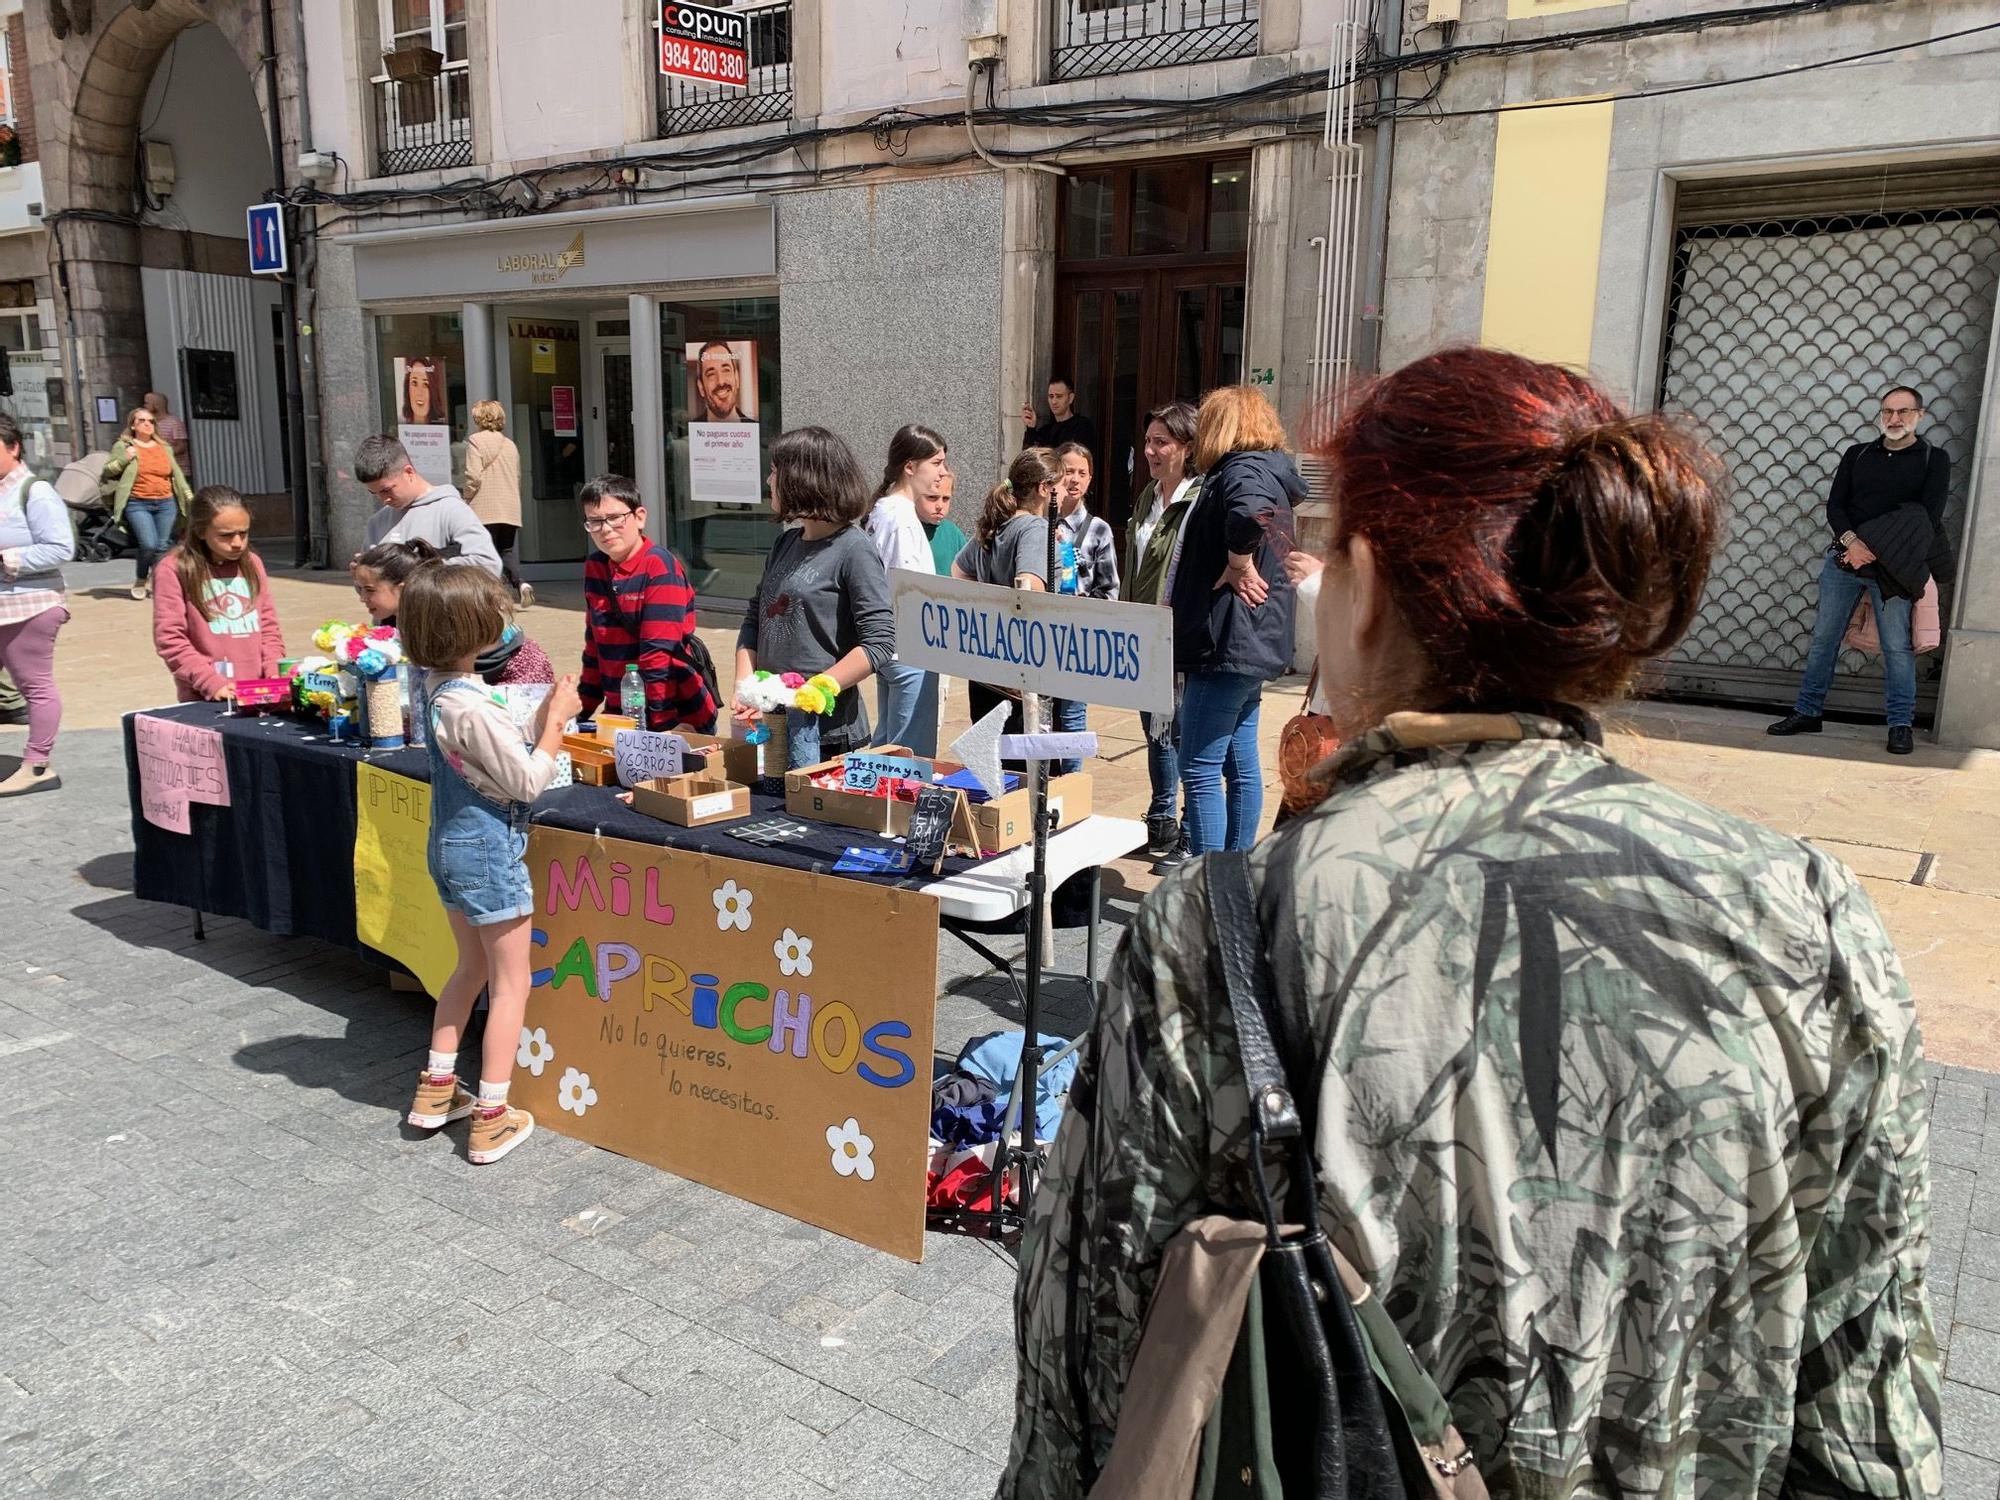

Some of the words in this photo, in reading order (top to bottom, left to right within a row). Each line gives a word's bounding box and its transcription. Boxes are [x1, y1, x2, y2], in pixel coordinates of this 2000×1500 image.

[664, 5, 742, 39] copun
[665, 26, 697, 40] consulting
[664, 40, 691, 70] 984
[693, 46, 718, 75] 280
[719, 51, 744, 80] 380
[496, 253, 557, 273] LABORAL
[1250, 367, 1275, 385] 54
[696, 429, 706, 438] No
[955, 606, 1047, 668] PALACIO
[1049, 622, 1141, 682] VALDES
[616, 732, 678, 755] PULSERAS
[915, 810, 939, 827] EN
[600, 1014, 624, 1045] No
[633, 1015, 648, 1047] lo
[668, 1069, 682, 1096] lo
